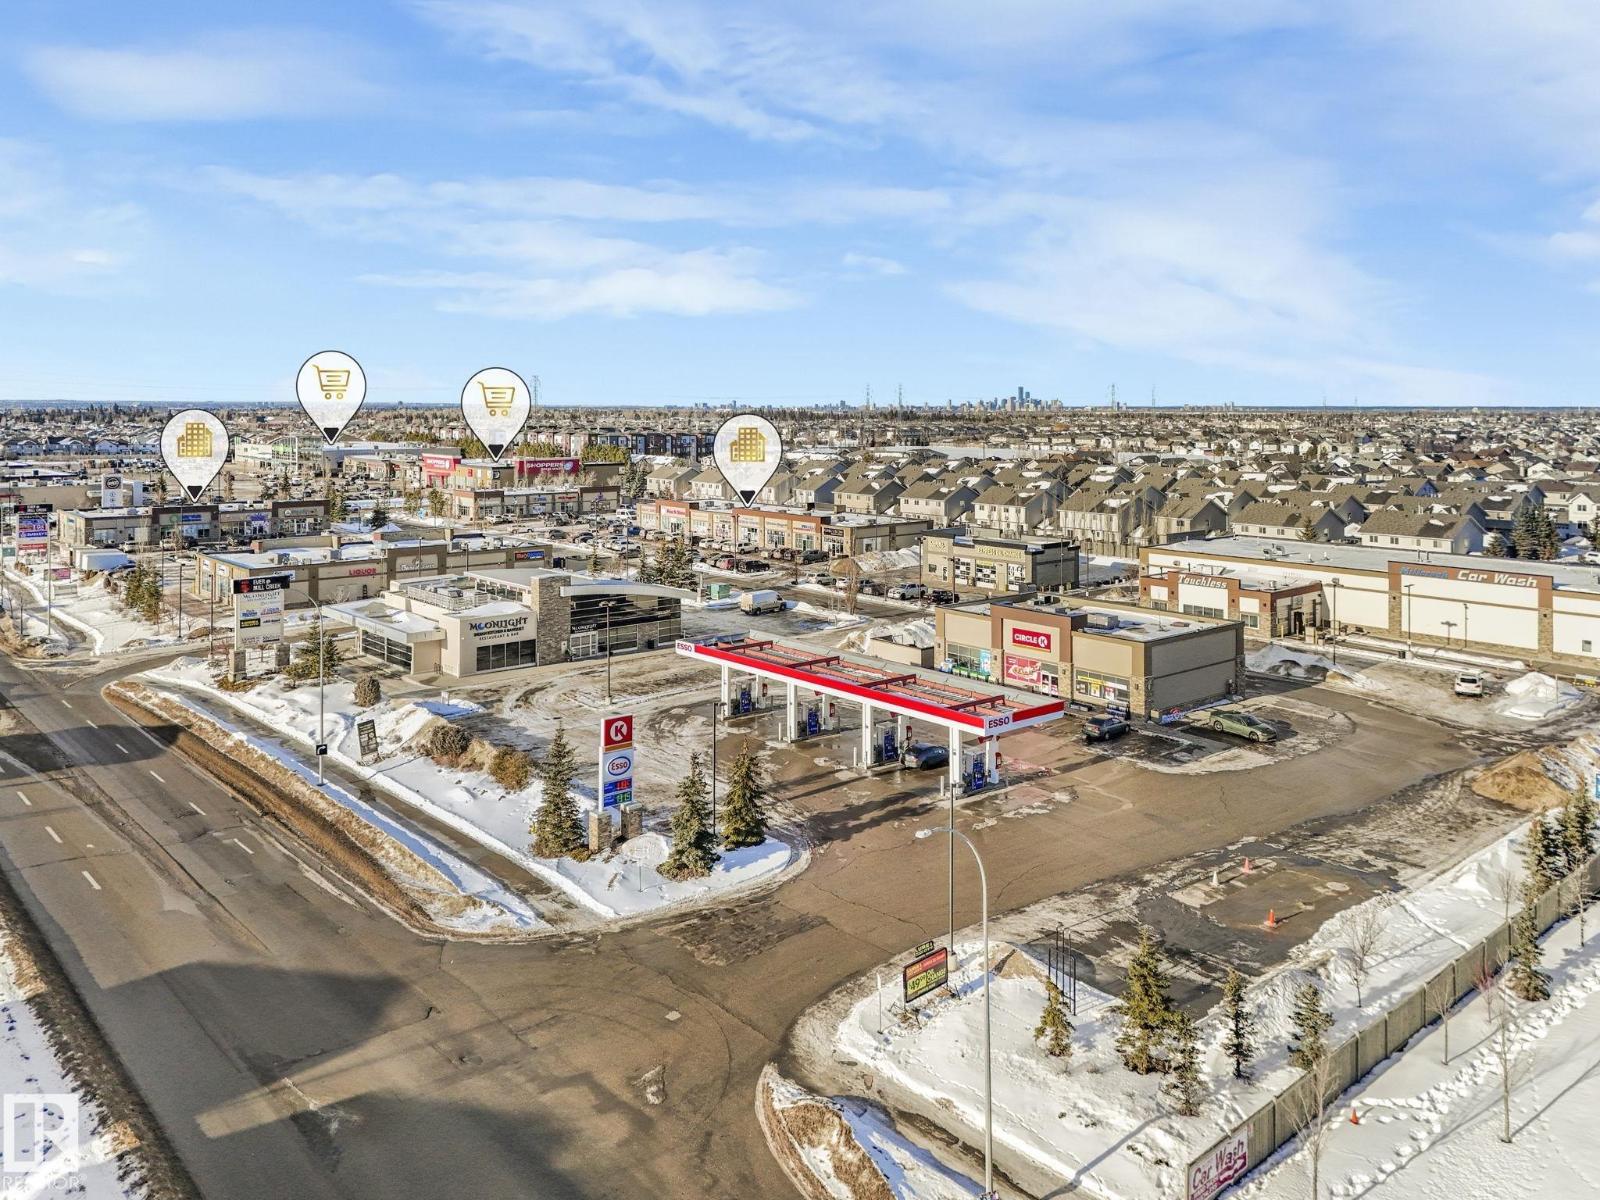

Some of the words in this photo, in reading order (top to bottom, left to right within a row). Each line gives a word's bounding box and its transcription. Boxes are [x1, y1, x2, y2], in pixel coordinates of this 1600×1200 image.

[348, 567, 377, 576] LIQUOR
[1178, 574, 1228, 589] Touchless
[1457, 570, 1487, 582] Car
[1494, 573, 1537, 588] Wash
[1014, 634, 1038, 644] CIRCLE
[676, 642, 693, 652] ESSO
[988, 716, 1010, 728] ESSO
[611, 761, 628, 771] Esso
[1193, 1166, 1212, 1190] Car
[1215, 1140, 1244, 1172] Wash
